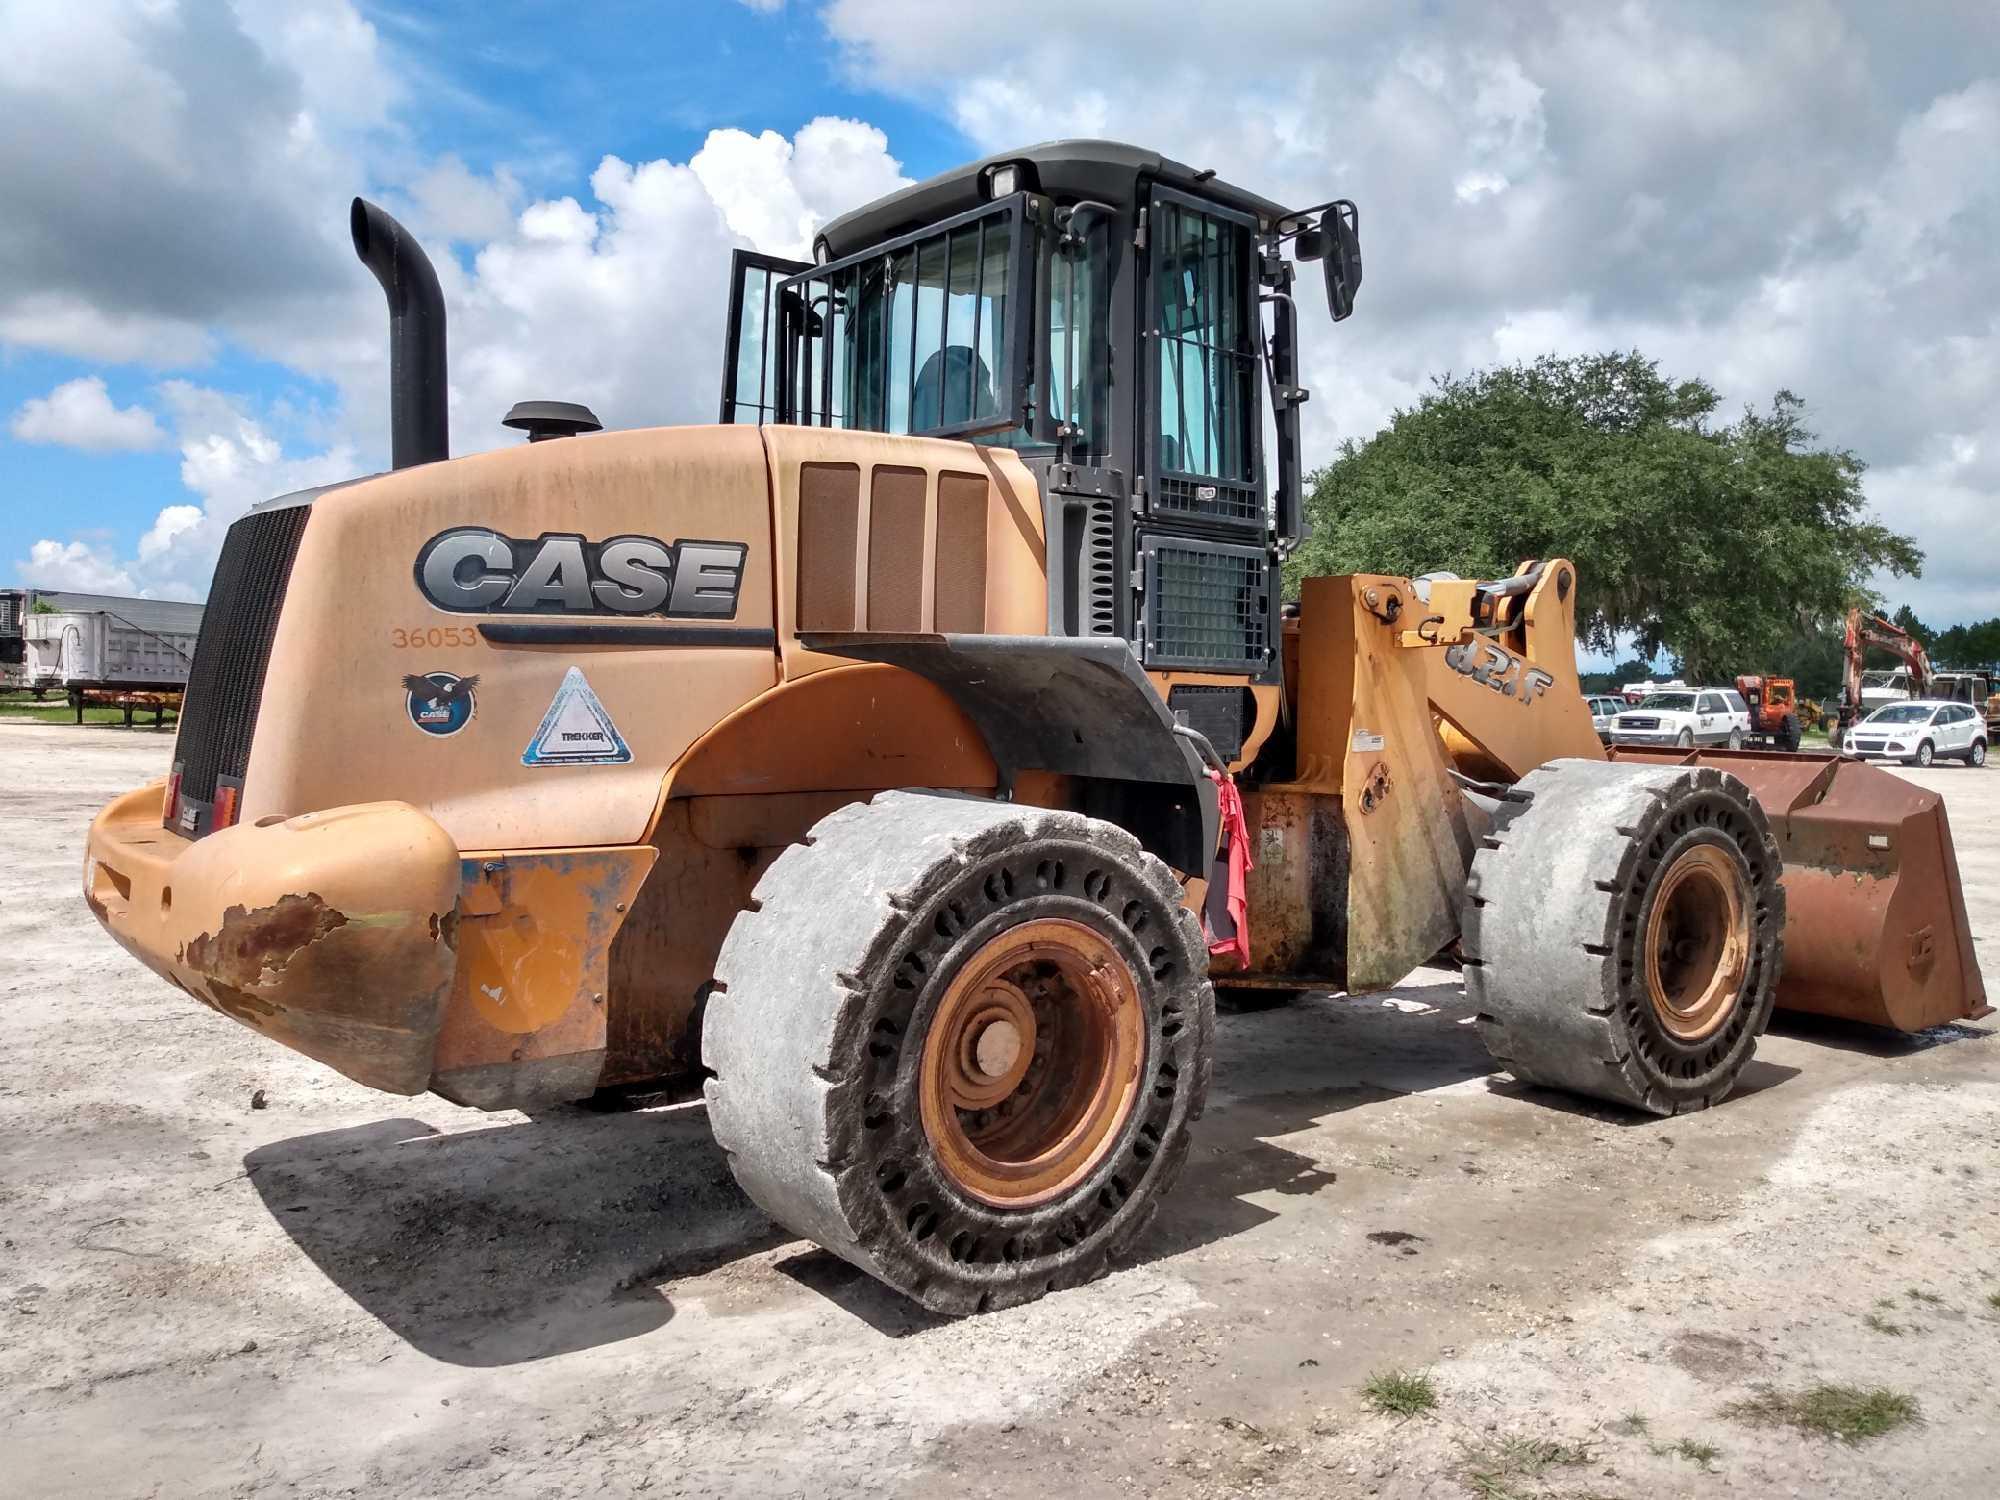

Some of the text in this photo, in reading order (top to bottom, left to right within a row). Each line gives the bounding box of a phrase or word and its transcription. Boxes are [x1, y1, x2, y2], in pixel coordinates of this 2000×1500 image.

[419, 529, 746, 617] CASE
[391, 627, 477, 648] 36053
[561, 732, 605, 742] TREKKER
